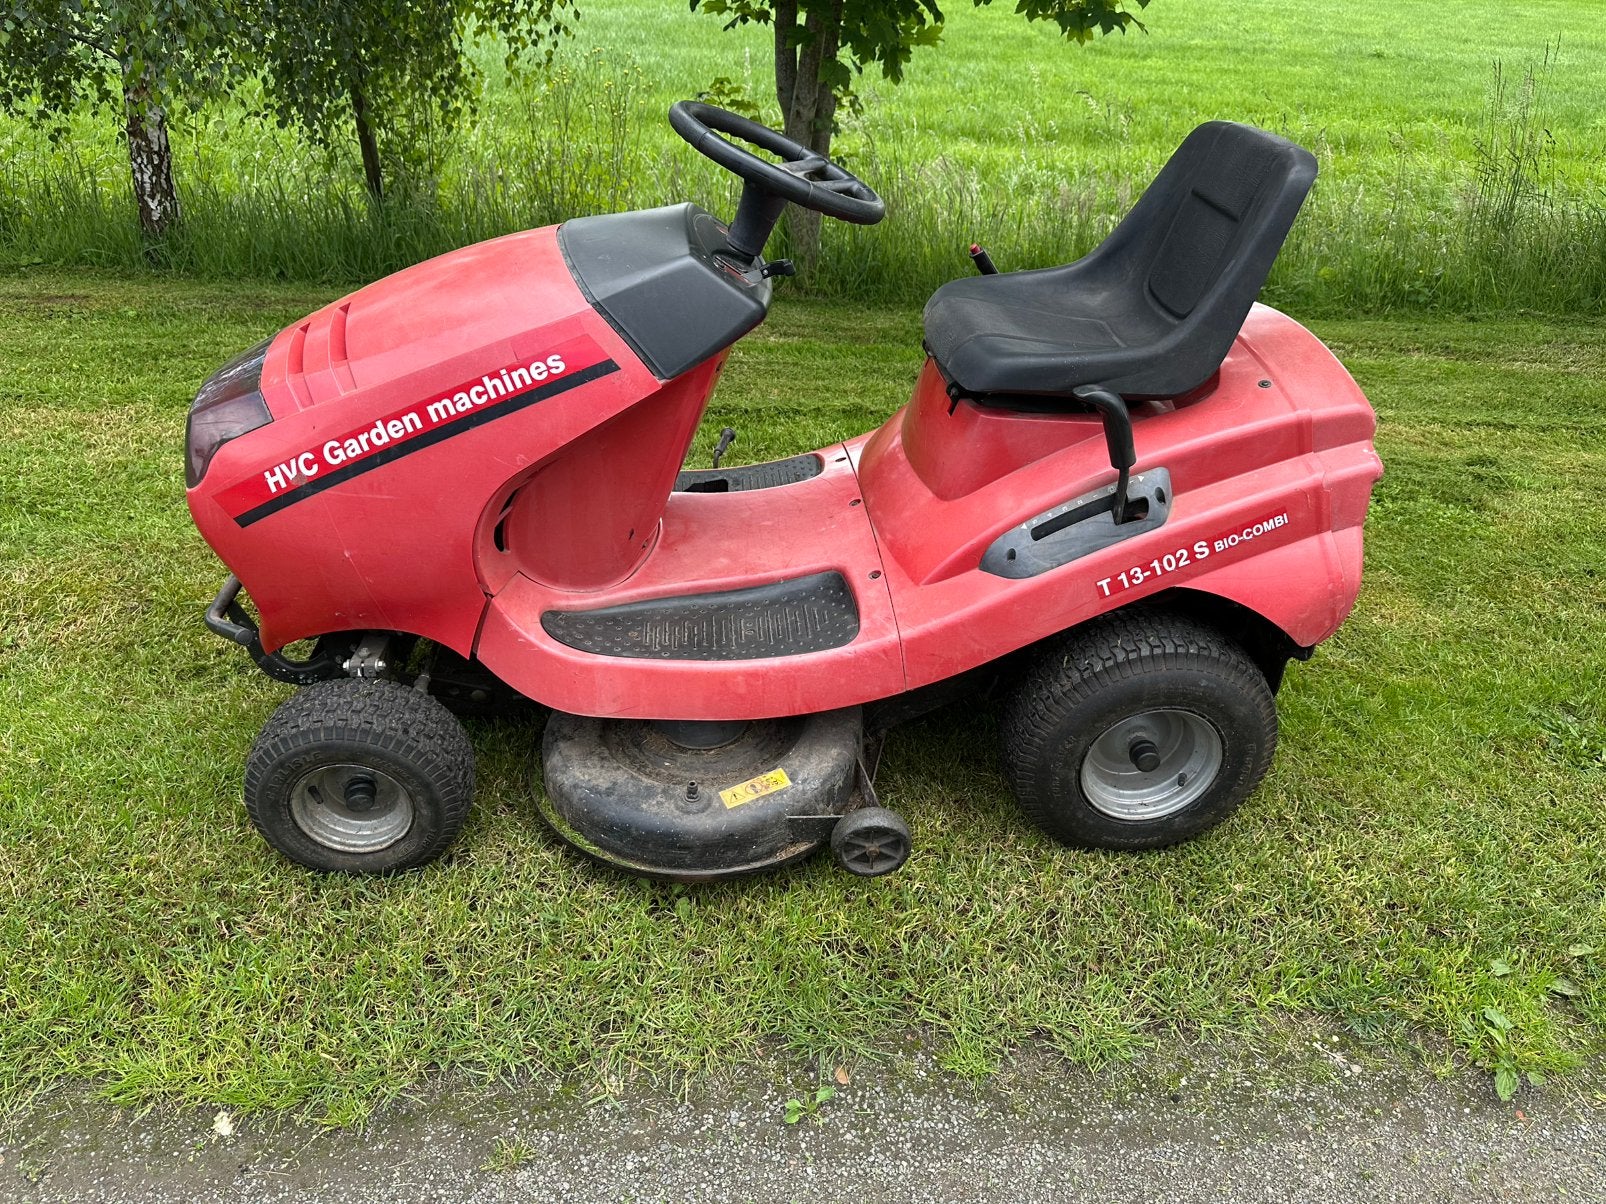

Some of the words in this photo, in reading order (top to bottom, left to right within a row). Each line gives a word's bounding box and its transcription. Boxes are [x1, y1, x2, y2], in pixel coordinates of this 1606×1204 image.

[264, 452, 319, 493] HVC
[323, 412, 423, 465] Garden
[426, 353, 566, 423] machines
[1096, 577, 1111, 596] T
[1117, 548, 1191, 589] 13-102
[1193, 540, 1210, 559] S
[1213, 513, 1289, 553] BIO-COMBI
